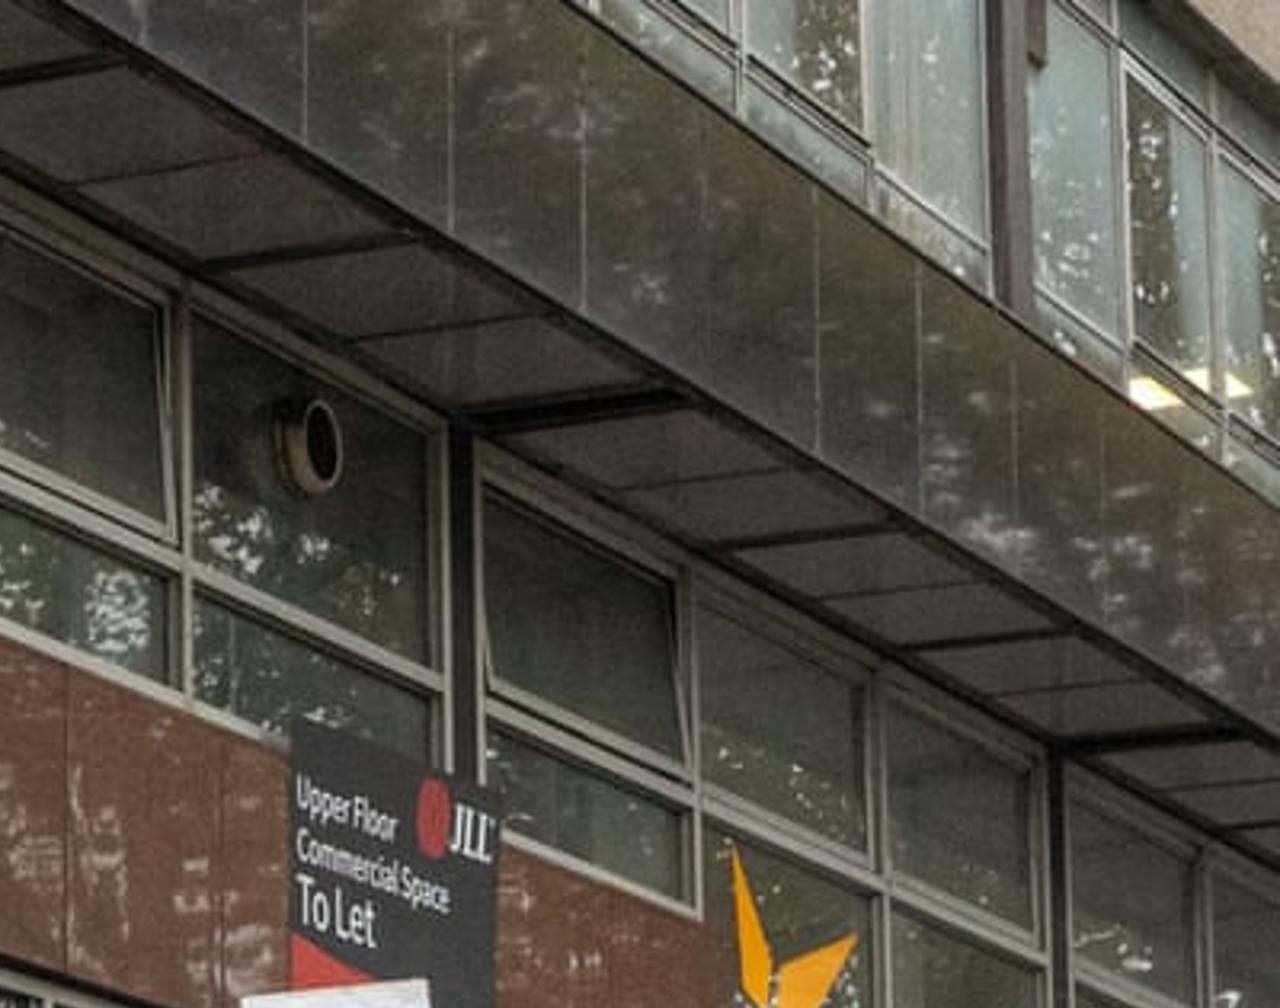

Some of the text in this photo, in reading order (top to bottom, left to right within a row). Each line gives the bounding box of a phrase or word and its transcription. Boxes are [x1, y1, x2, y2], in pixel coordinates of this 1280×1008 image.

[297, 773, 399, 843] Upper Floor
[450, 803, 493, 864] JLL
[296, 828, 451, 914] Commercial Space
[295, 873, 377, 948] To Let
